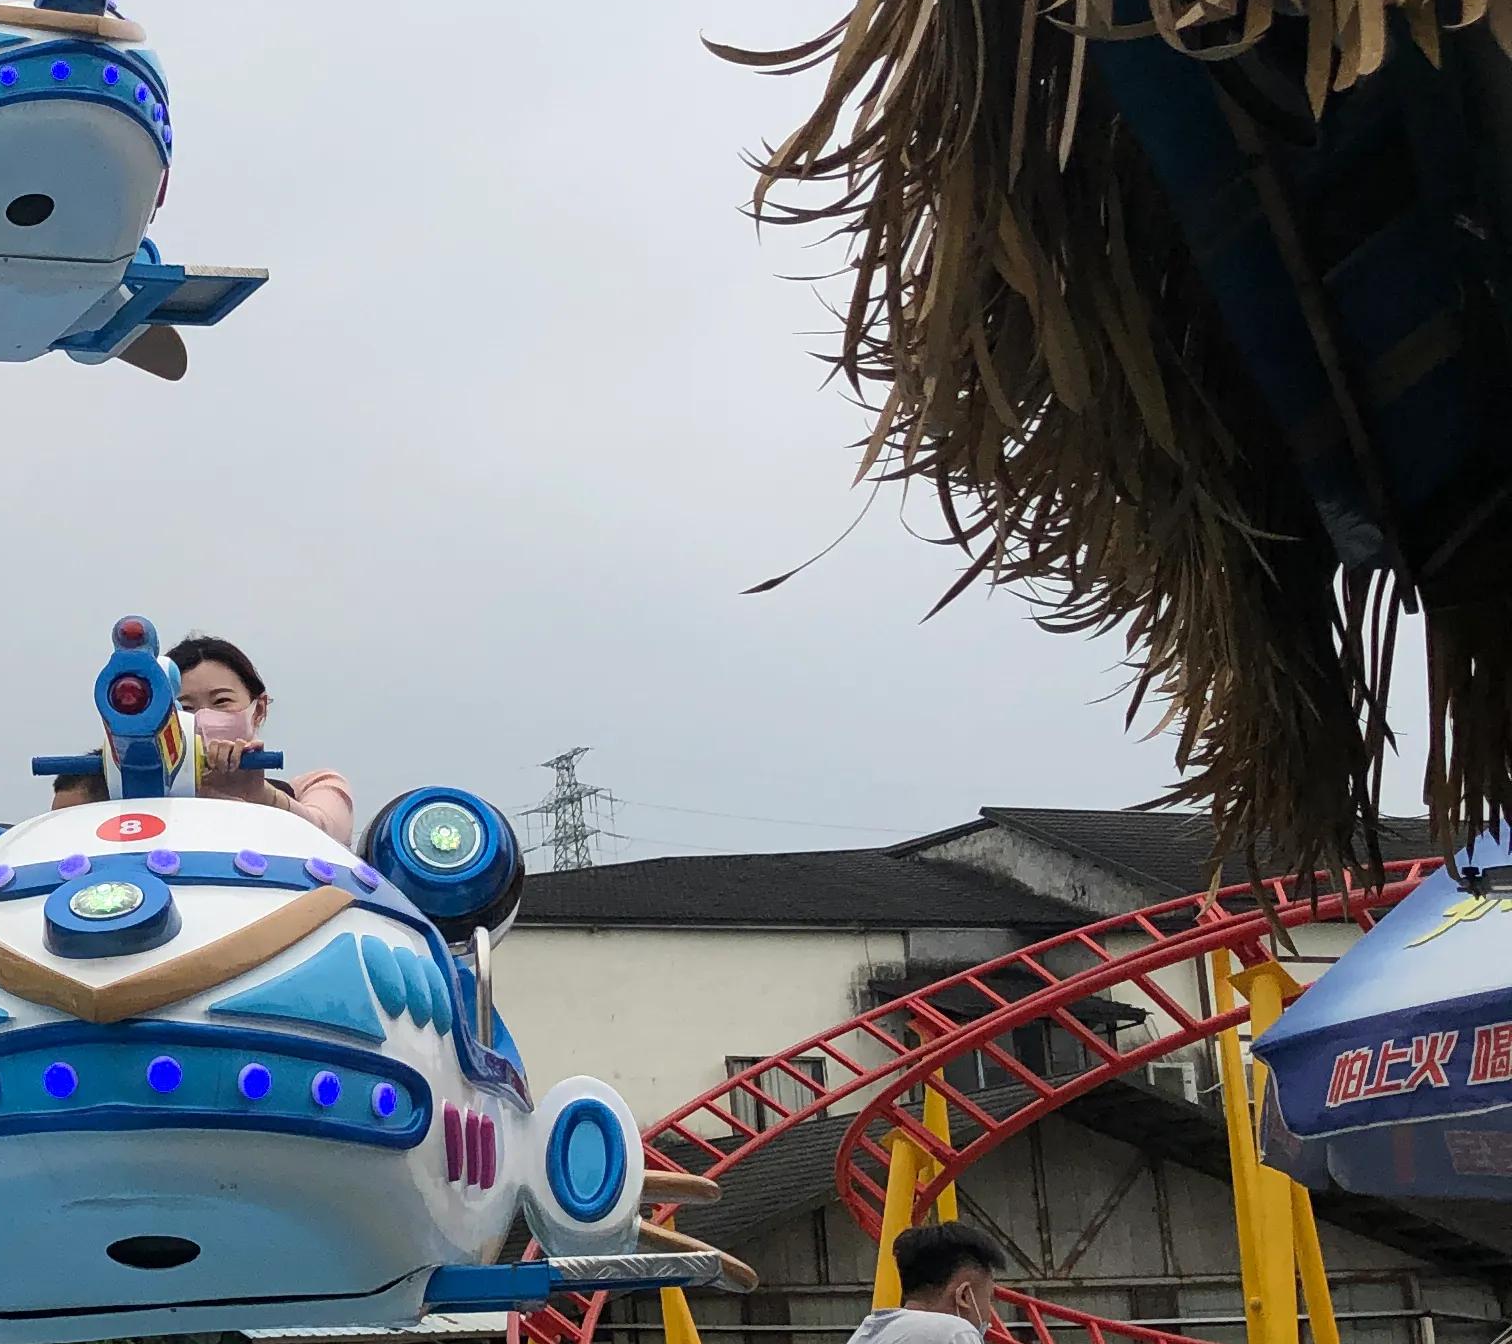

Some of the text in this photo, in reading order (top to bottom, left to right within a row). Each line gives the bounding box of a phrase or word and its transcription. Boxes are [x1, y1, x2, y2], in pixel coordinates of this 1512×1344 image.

[120, 819, 143, 834] 8
[1325, 1030, 1459, 1108] 怕上火
